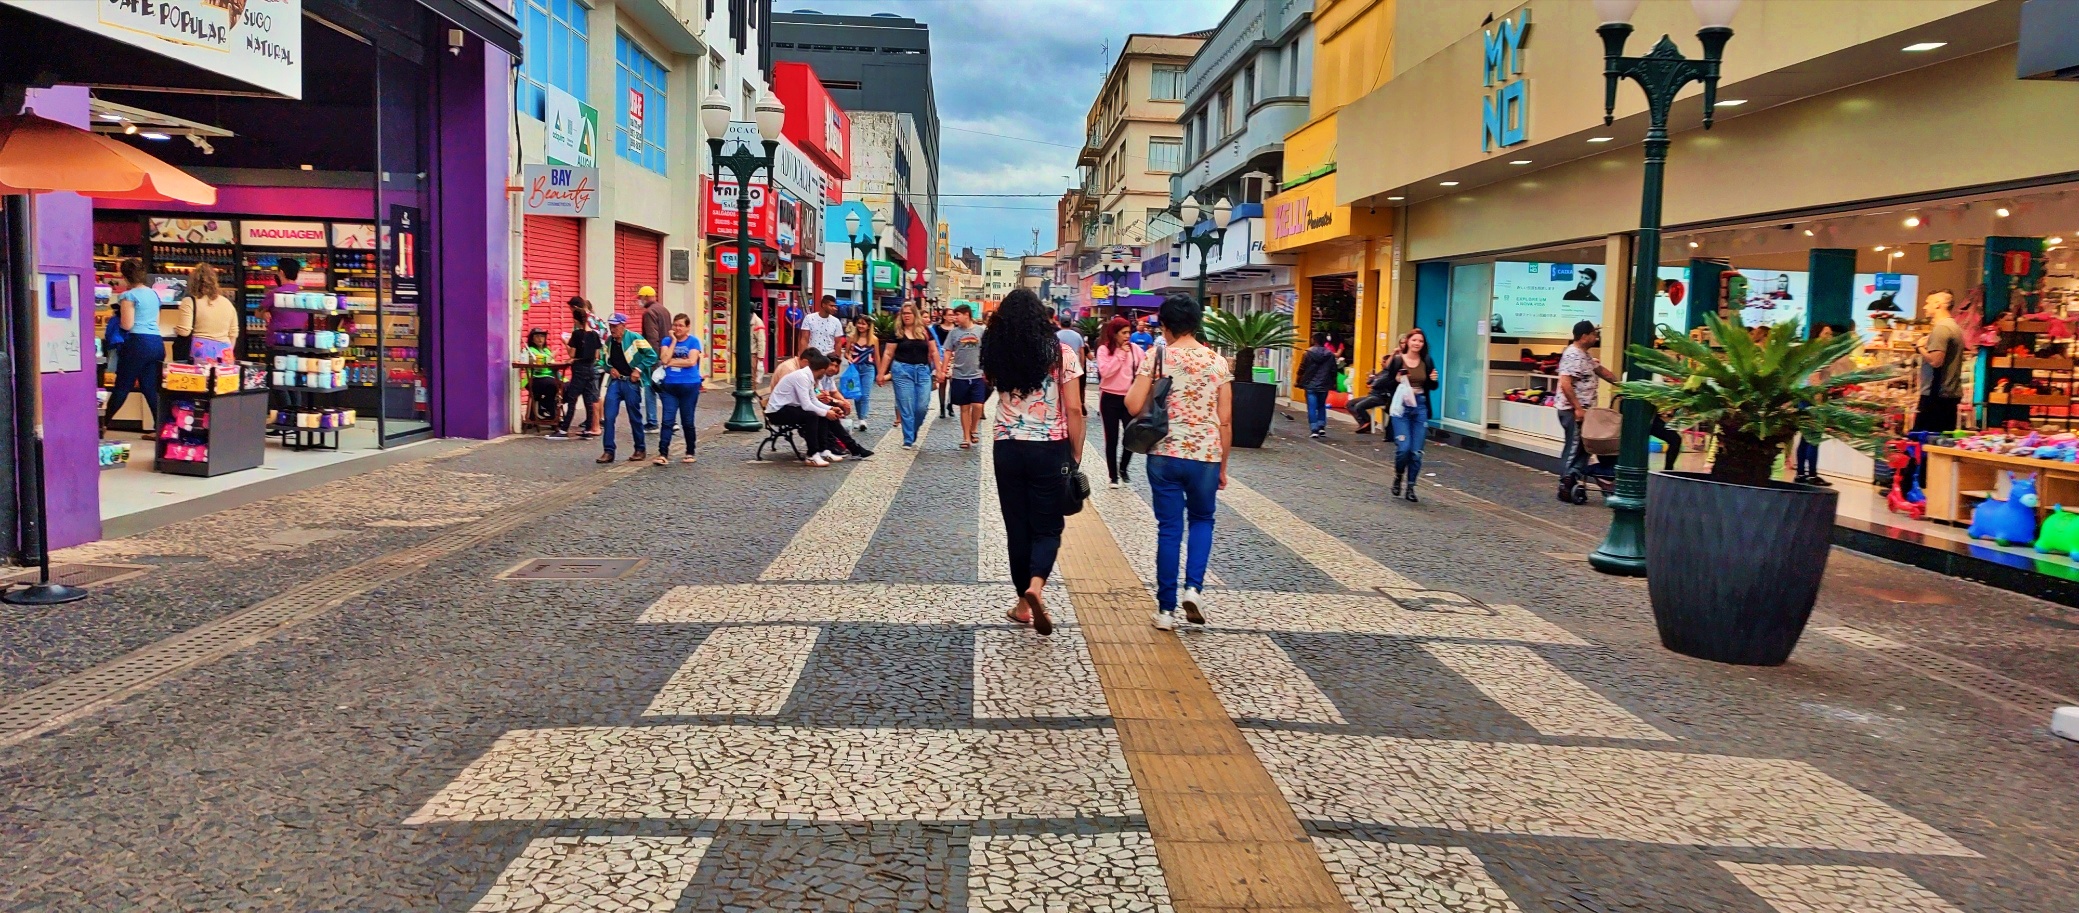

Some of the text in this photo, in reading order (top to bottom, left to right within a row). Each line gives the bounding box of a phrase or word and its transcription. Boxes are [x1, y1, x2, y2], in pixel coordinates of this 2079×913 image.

[159, 2, 227, 45] POPULAR
[243, 8, 272, 33] SUCO
[246, 34, 294, 66] NATURAL
[1483, 8, 1531, 87] MY
[551, 169, 573, 187] BAY
[528, 176, 595, 213] Beauty
[715, 187, 760, 200] TAIO
[1275, 196, 1310, 240] KELLY
[250, 228, 324, 240] MAQUIAGEM
[722, 255, 753, 263] TAIO
